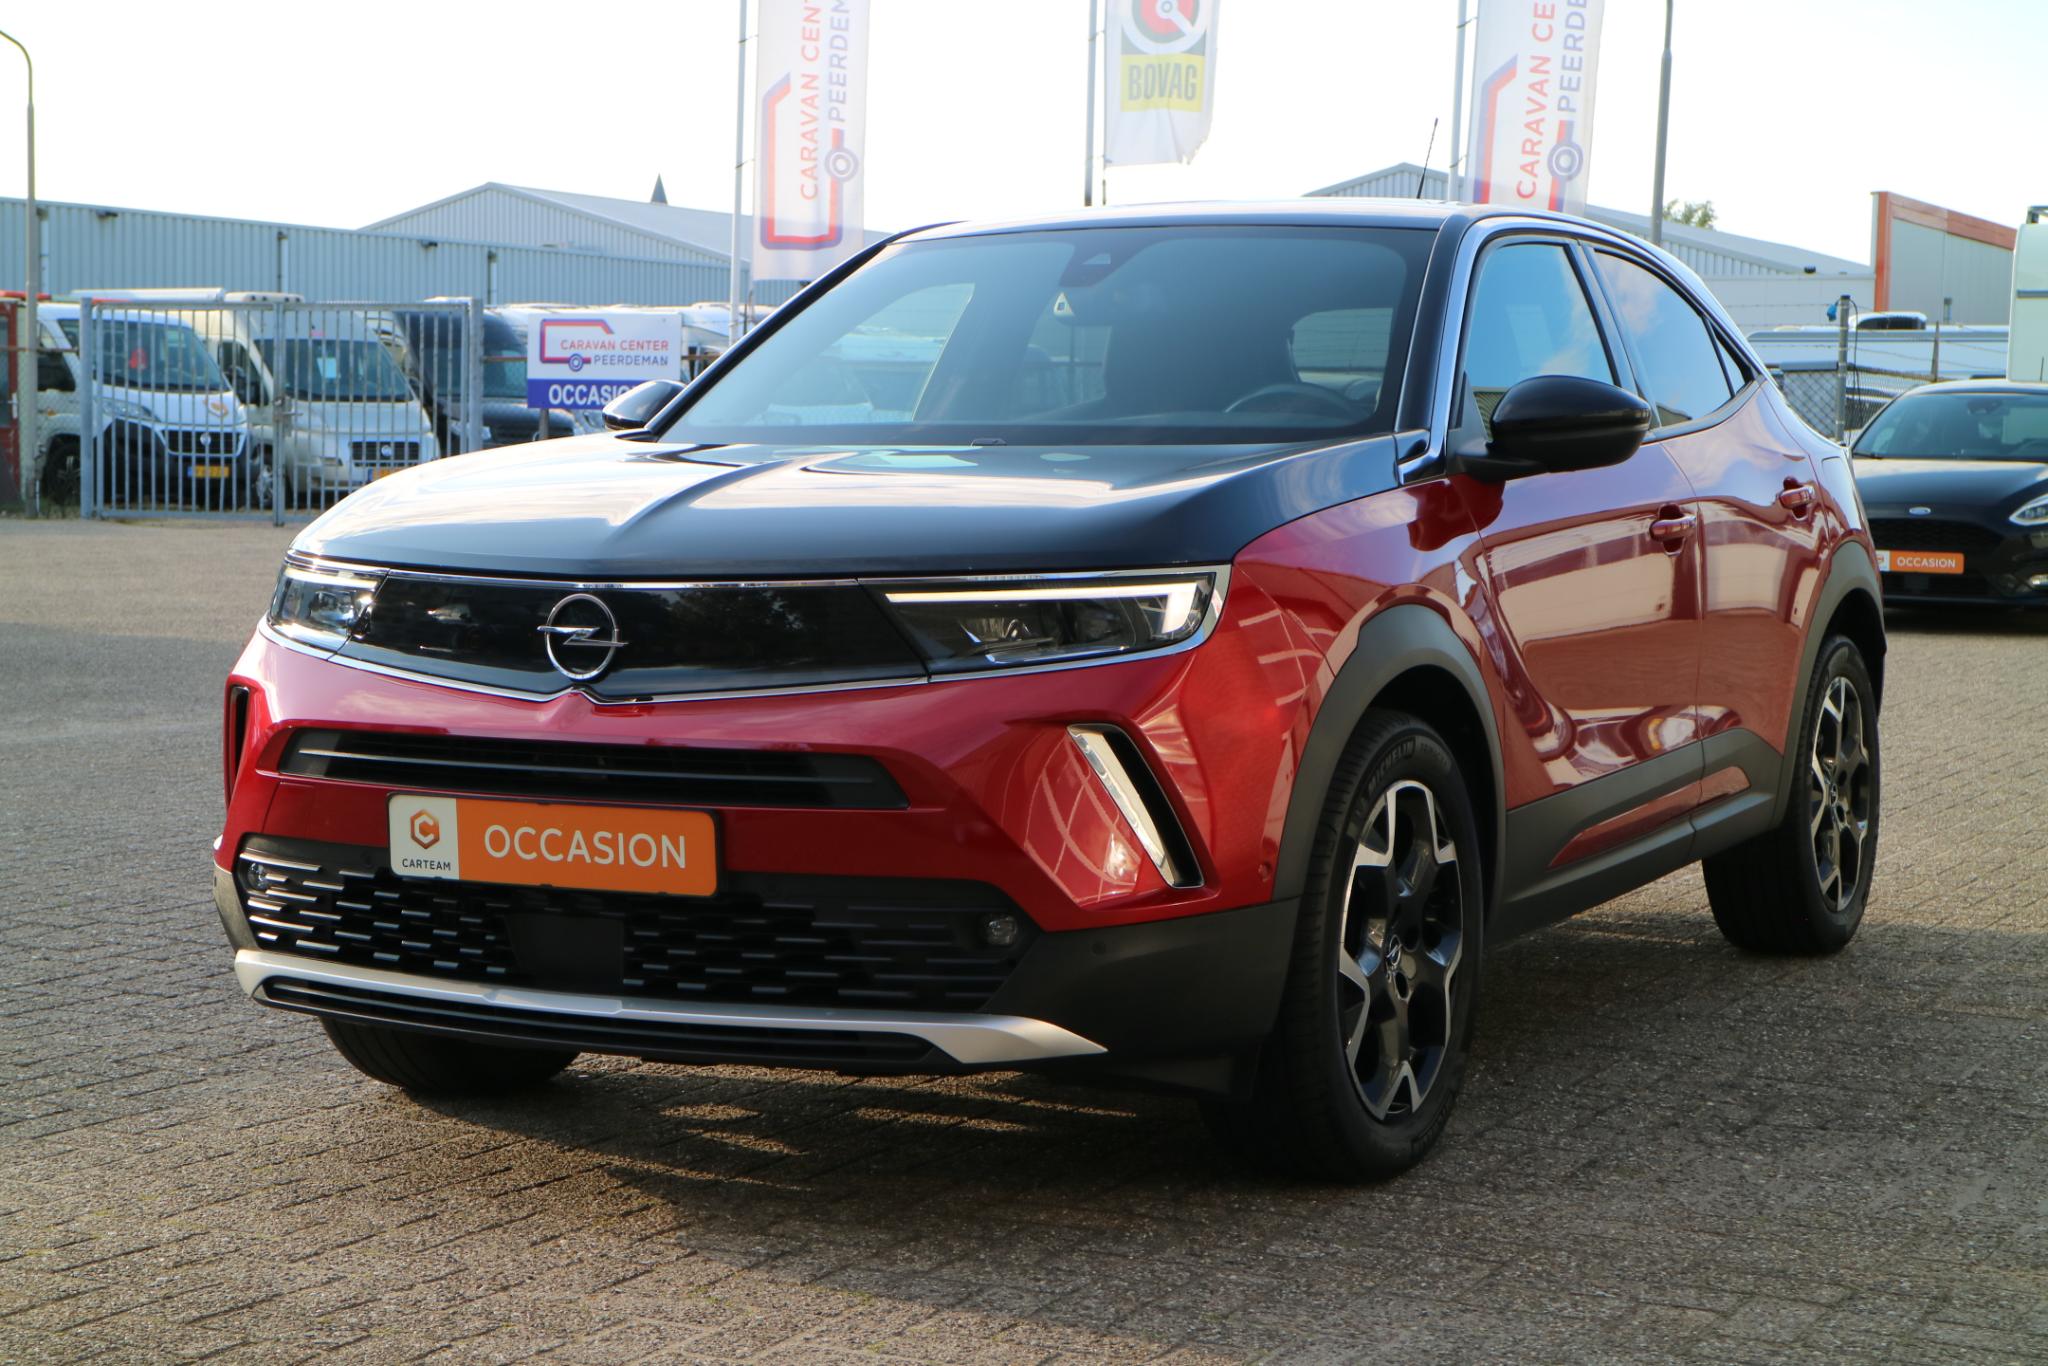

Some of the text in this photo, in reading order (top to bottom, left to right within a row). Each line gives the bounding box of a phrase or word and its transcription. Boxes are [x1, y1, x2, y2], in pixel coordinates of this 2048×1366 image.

[1128, 62, 1198, 101] BOVAG
[800, 0, 821, 200] CARAVAN CEN
[1516, 55, 1551, 199] CARAVAN
[560, 339, 669, 351] CARAVAN CENTER
[594, 355, 669, 366] PEERDEMAN
[1896, 556, 1956, 569] OCCASION
[484, 824, 686, 869] OCCASION
[402, 858, 451, 872] CARTEAM
